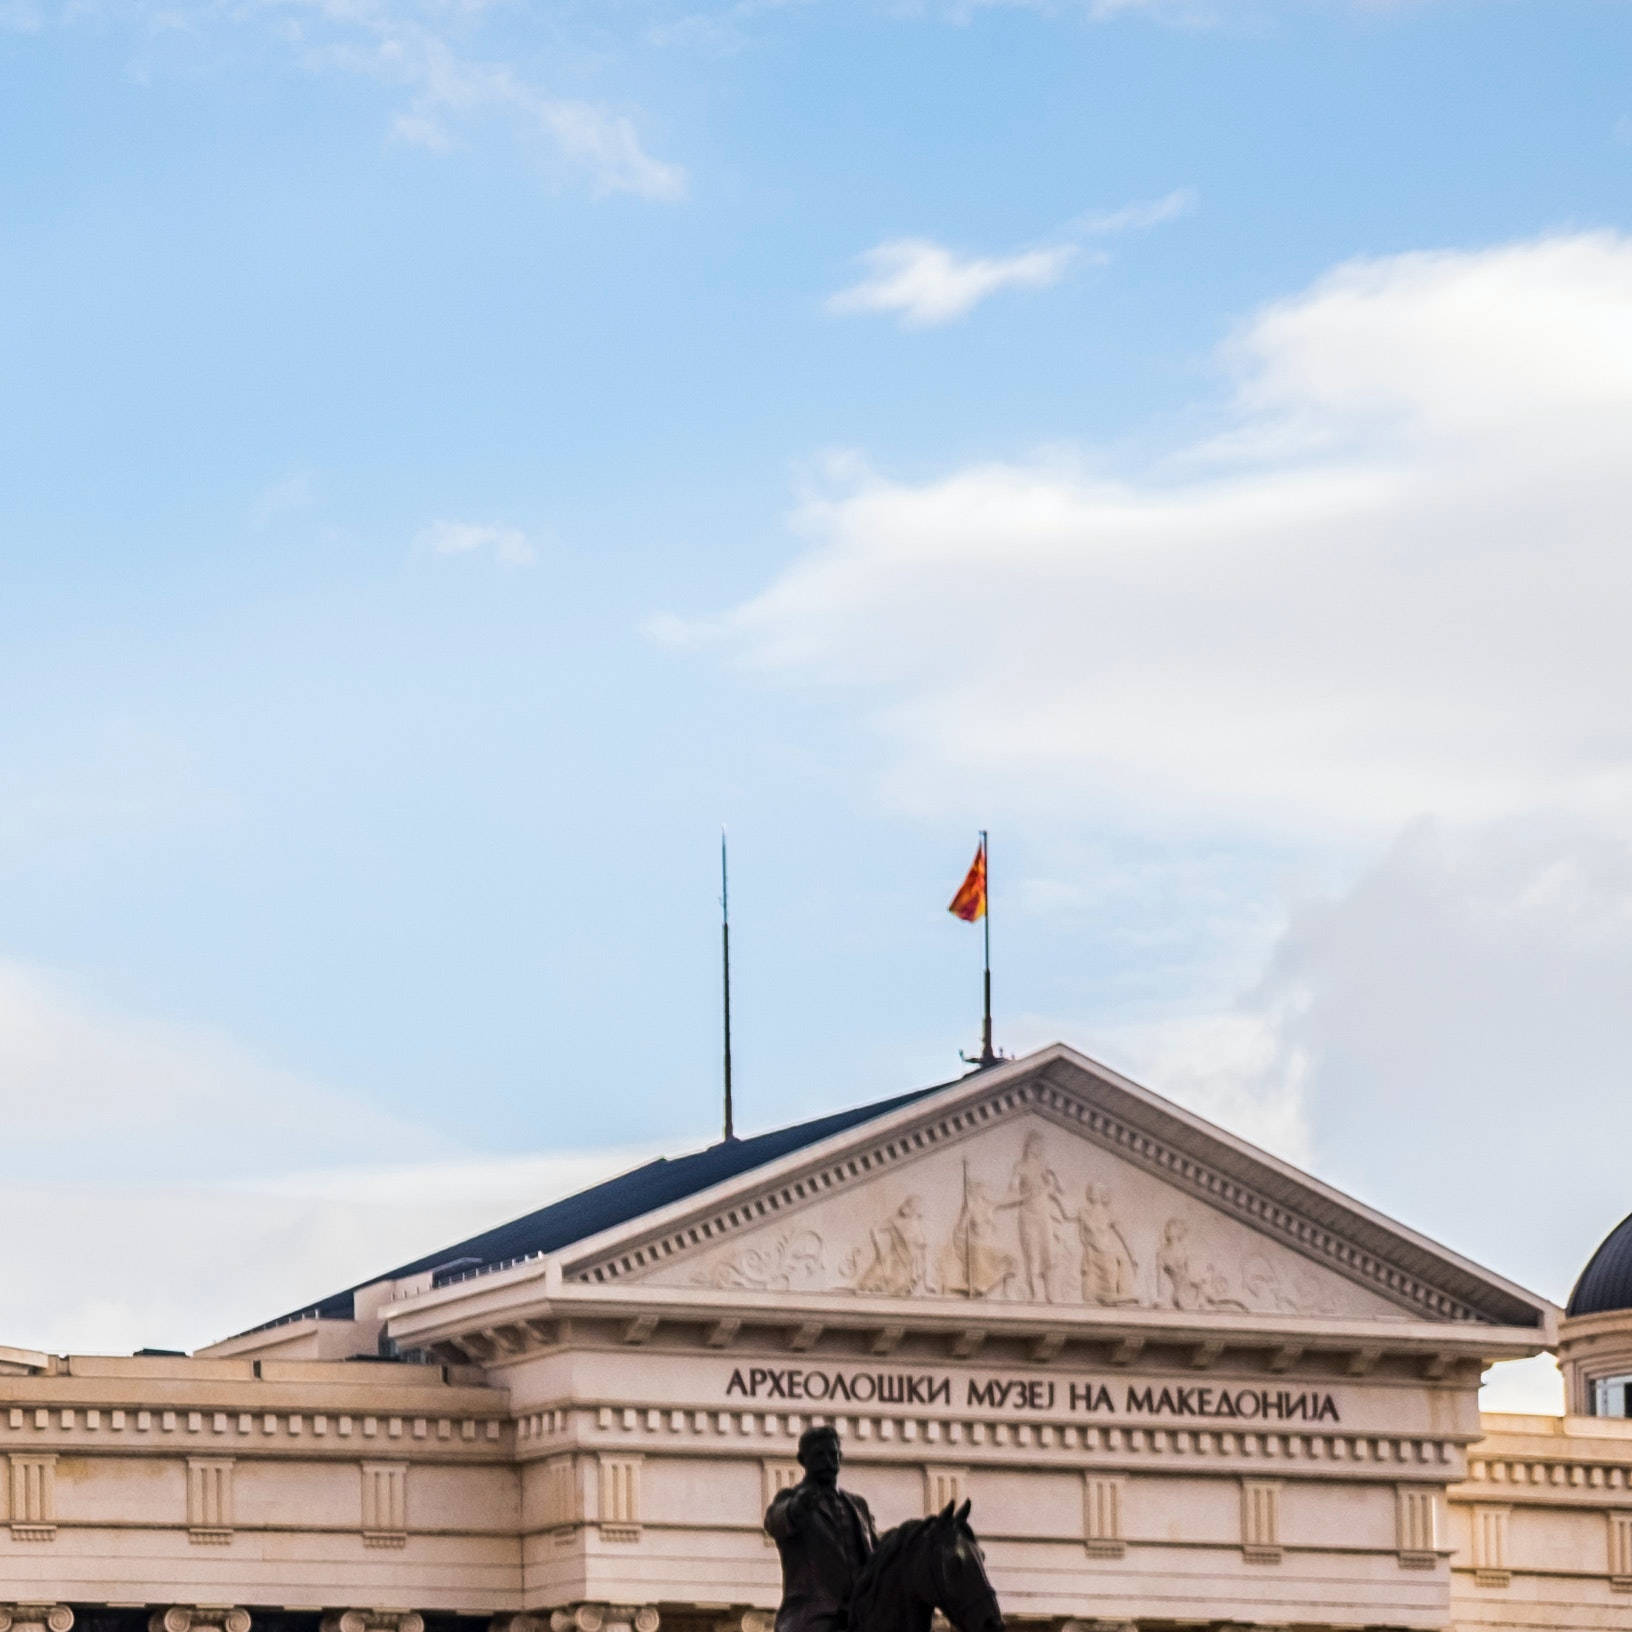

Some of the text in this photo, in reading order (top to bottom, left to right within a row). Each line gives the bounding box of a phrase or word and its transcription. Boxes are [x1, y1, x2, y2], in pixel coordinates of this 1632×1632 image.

[725, 1367, 1341, 1422] АРХЕОЛОШКИ МУЗЕЈ НА МАКЕДОНИЈА
